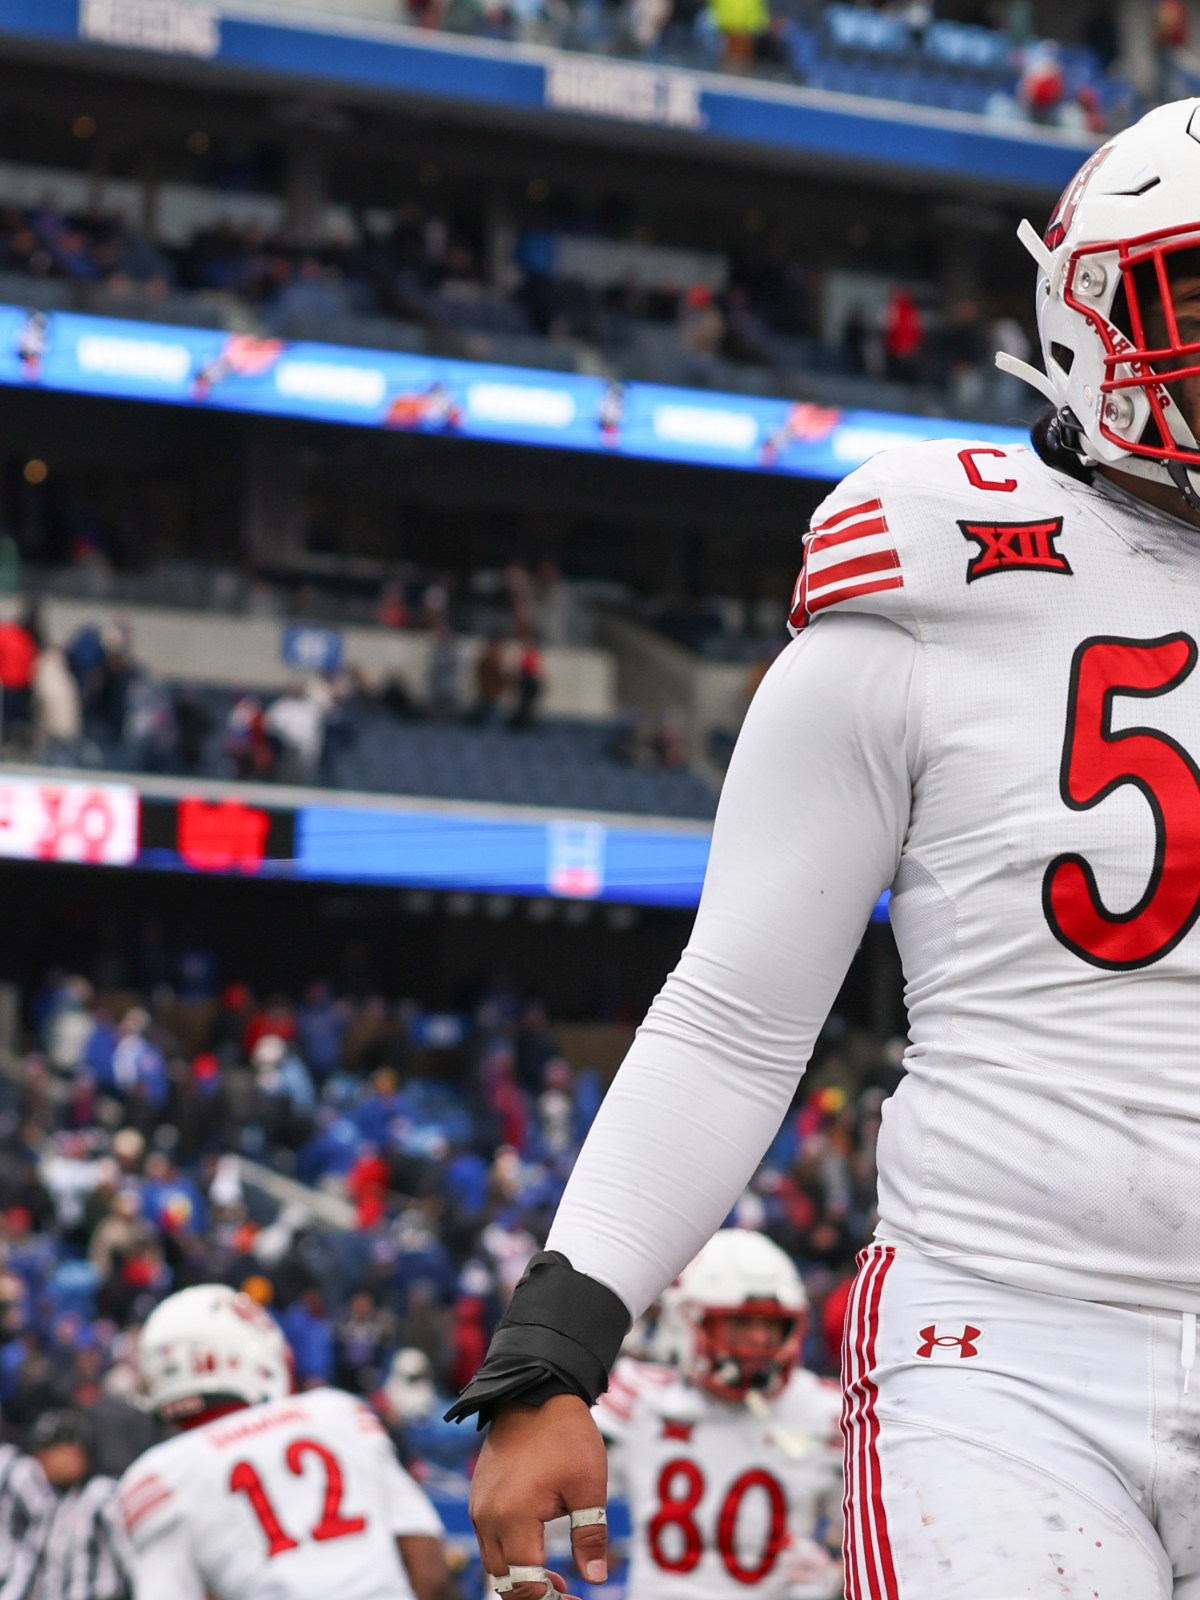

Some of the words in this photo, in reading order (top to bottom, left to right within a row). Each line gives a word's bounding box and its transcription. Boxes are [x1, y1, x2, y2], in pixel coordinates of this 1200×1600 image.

[958, 449, 1018, 492] C
[957, 516, 1074, 584] XII
[229, 1431, 366, 1559] 12
[646, 1457, 789, 1586] 80
